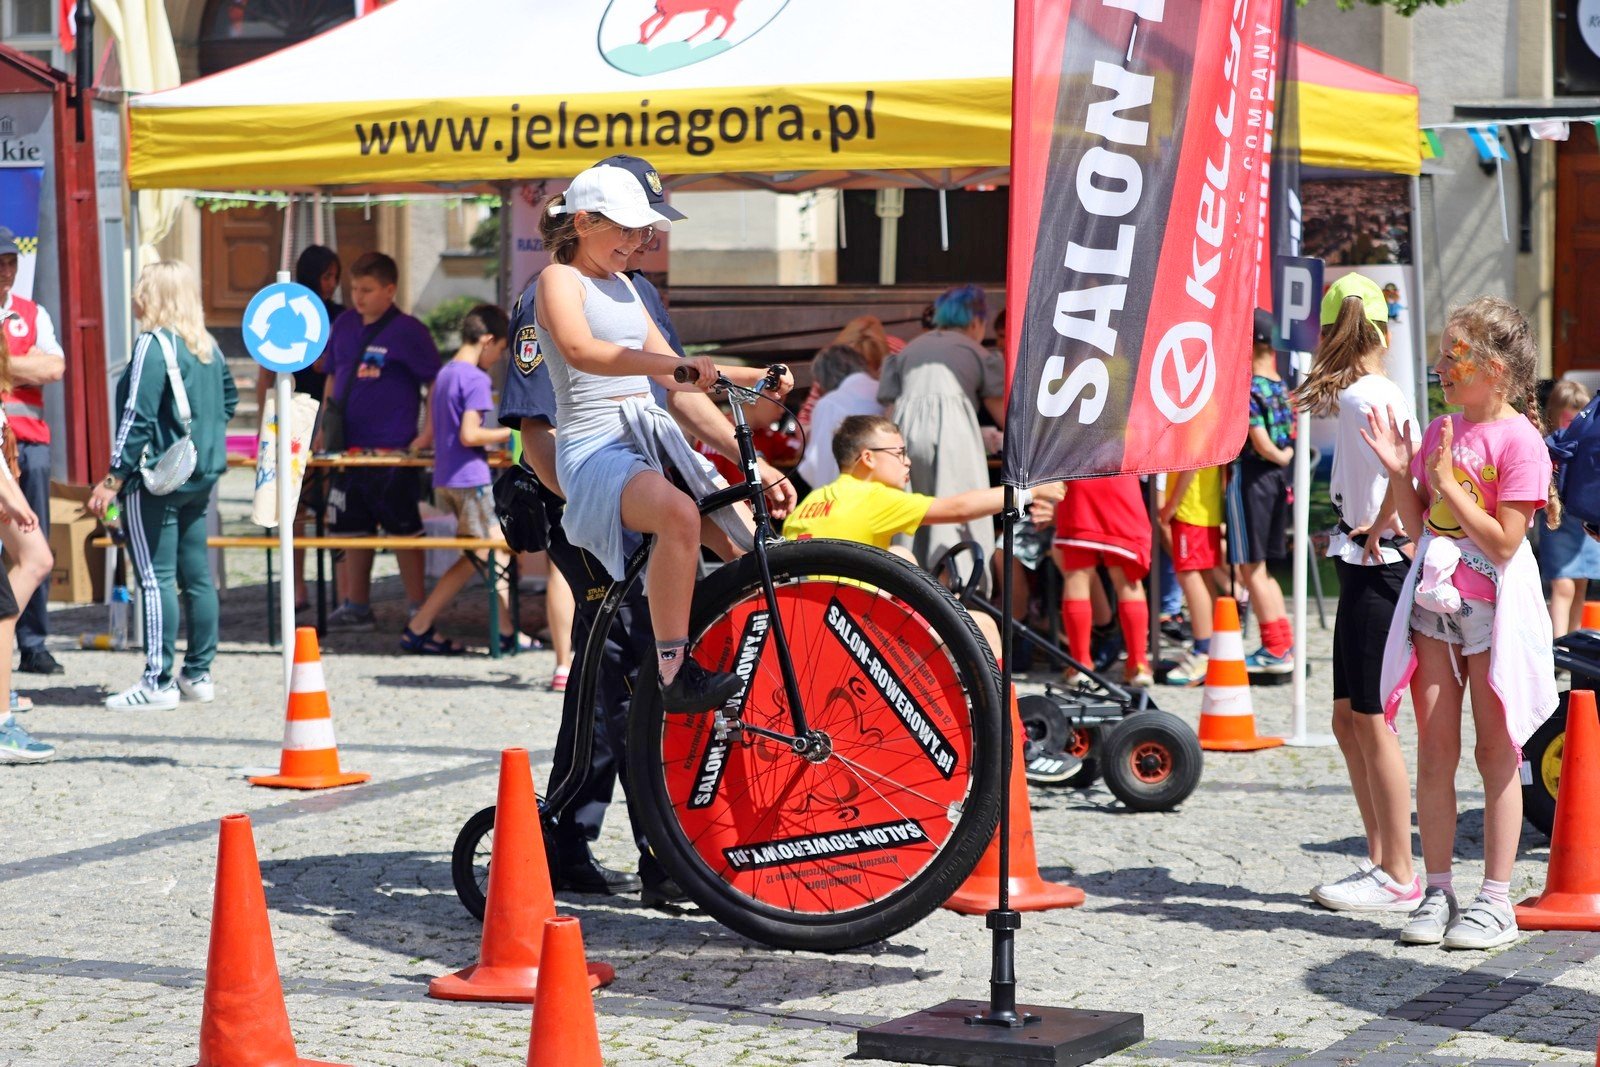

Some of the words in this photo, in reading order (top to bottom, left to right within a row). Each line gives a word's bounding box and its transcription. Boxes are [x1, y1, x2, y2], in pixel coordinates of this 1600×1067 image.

[1243, 23, 1272, 170] COMPANY
[355, 90, 876, 162] www.jeleniagora.pl
[1281, 266, 1313, 340] P
[799, 500, 835, 520] LEON
[828, 605, 954, 773] SALON-ROWEROWY.pl
[940, 712, 953, 726] 12
[728, 823, 923, 867] SALON-ROWEROWY.pl
[765, 874, 775, 884] 12
